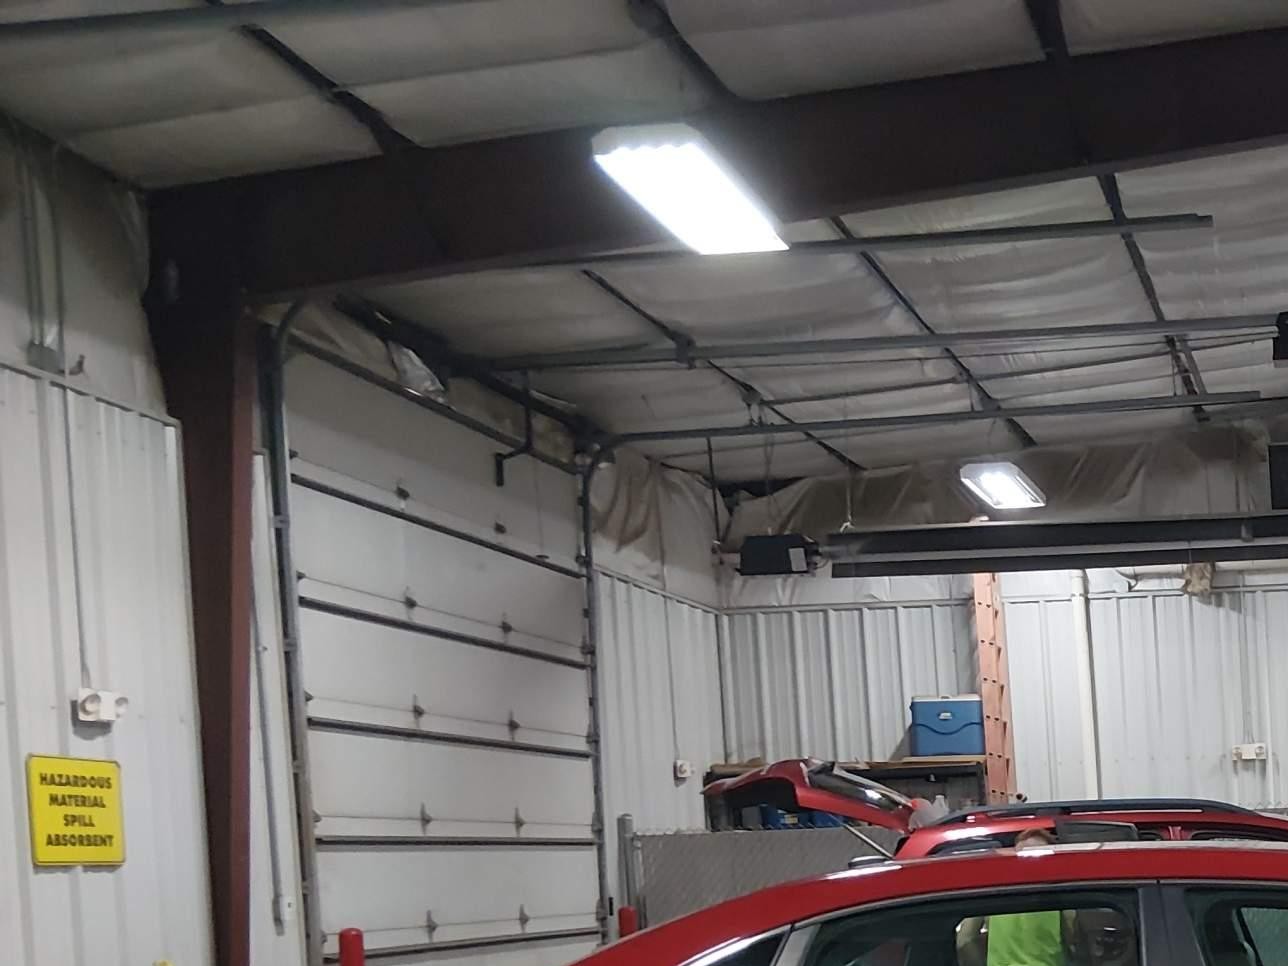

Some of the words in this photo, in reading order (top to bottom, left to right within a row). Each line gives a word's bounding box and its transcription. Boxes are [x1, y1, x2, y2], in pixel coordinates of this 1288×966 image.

[39, 773, 112, 789] HAZARDOUS
[49, 793, 106, 808] MATERIAL
[63, 814, 96, 828] SPILL
[46, 834, 114, 847] ABSORBENT
